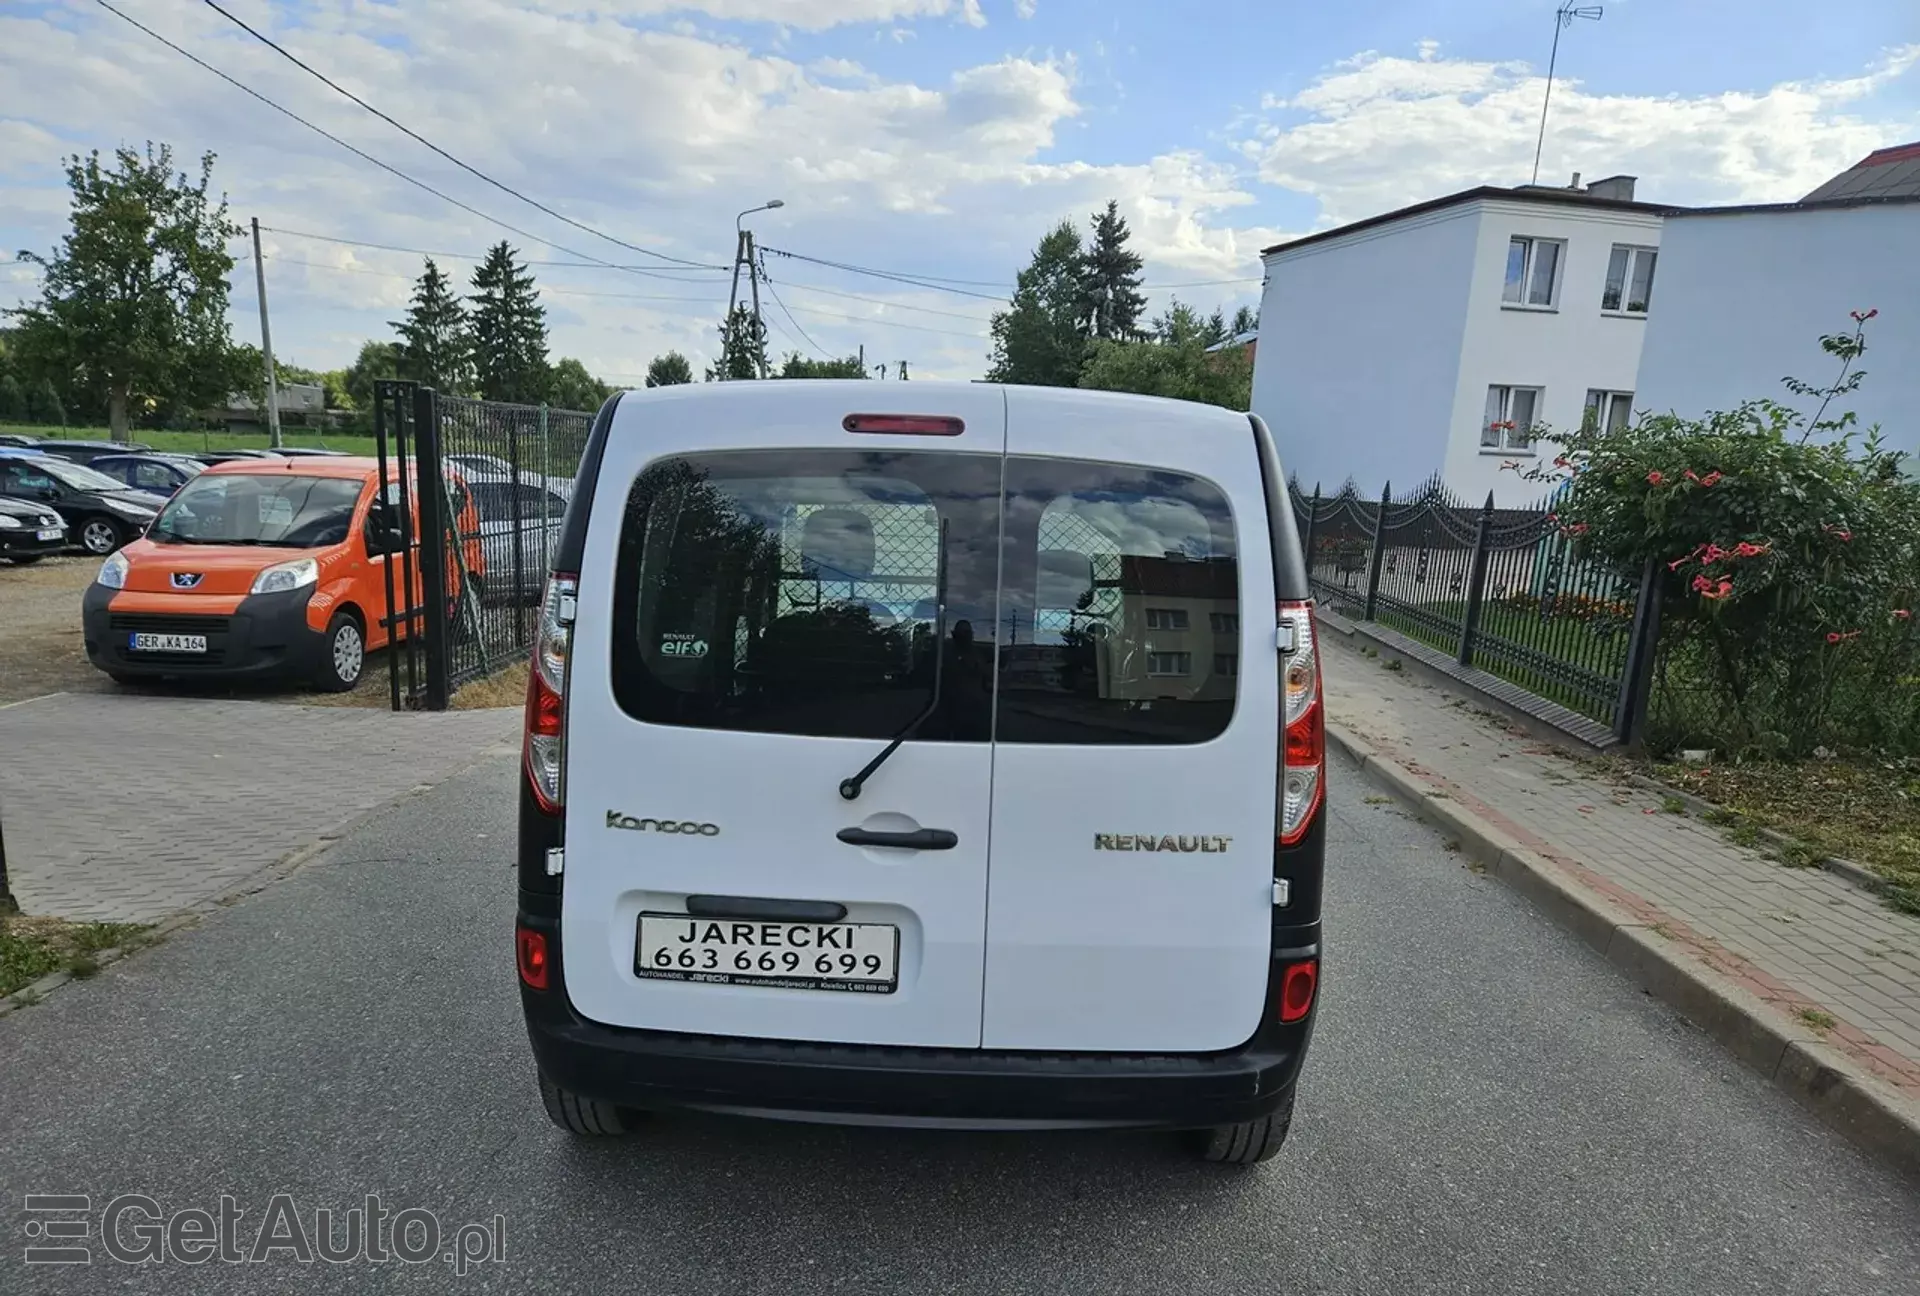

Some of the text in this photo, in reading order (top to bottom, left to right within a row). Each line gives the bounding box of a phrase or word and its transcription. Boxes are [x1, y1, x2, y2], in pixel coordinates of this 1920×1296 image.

[136, 634, 205, 649] GER KA 164
[1094, 832, 1234, 853] RENAULT
[678, 922, 854, 950] JARECKI
[654, 947, 882, 976] 663 669 699
[639, 970, 686, 980] AUTOHANDEL
